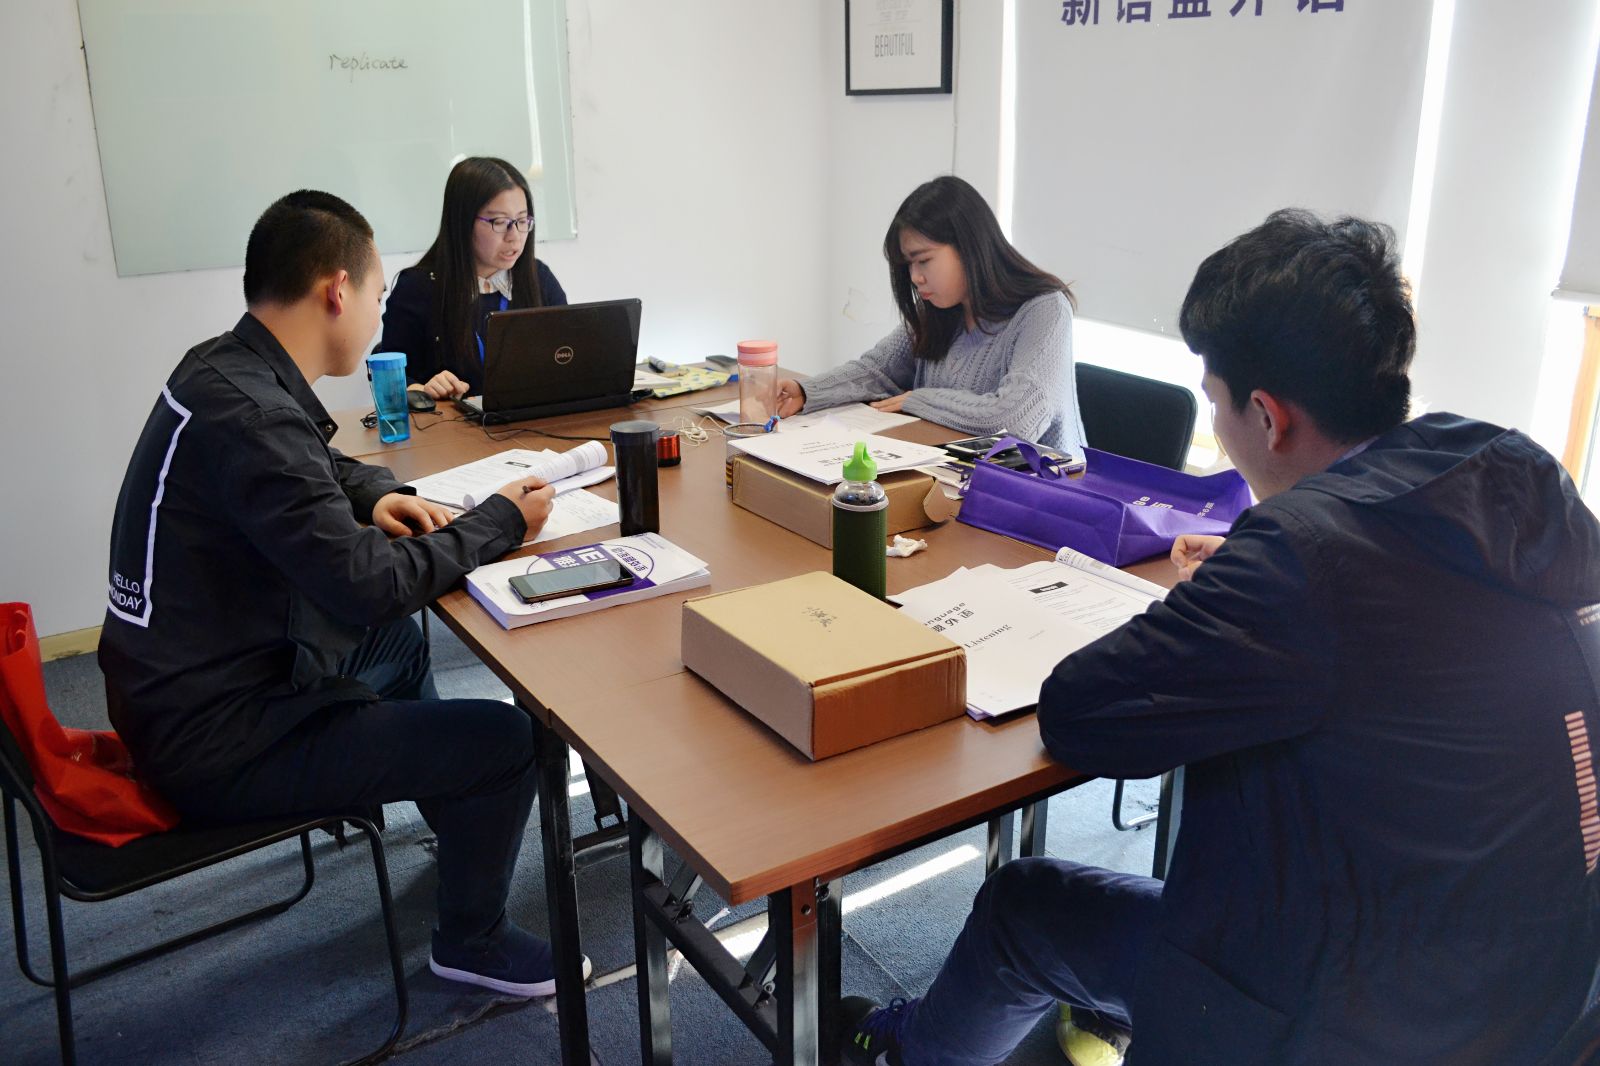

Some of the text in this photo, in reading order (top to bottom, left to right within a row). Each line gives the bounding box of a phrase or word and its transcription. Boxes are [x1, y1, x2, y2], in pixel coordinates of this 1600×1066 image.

[875, 33, 915, 57] BEAUTIFUL
[329, 51, 408, 84] replicate
[924, 602, 966, 626] nguage
[964, 623, 1013, 649] Listening
